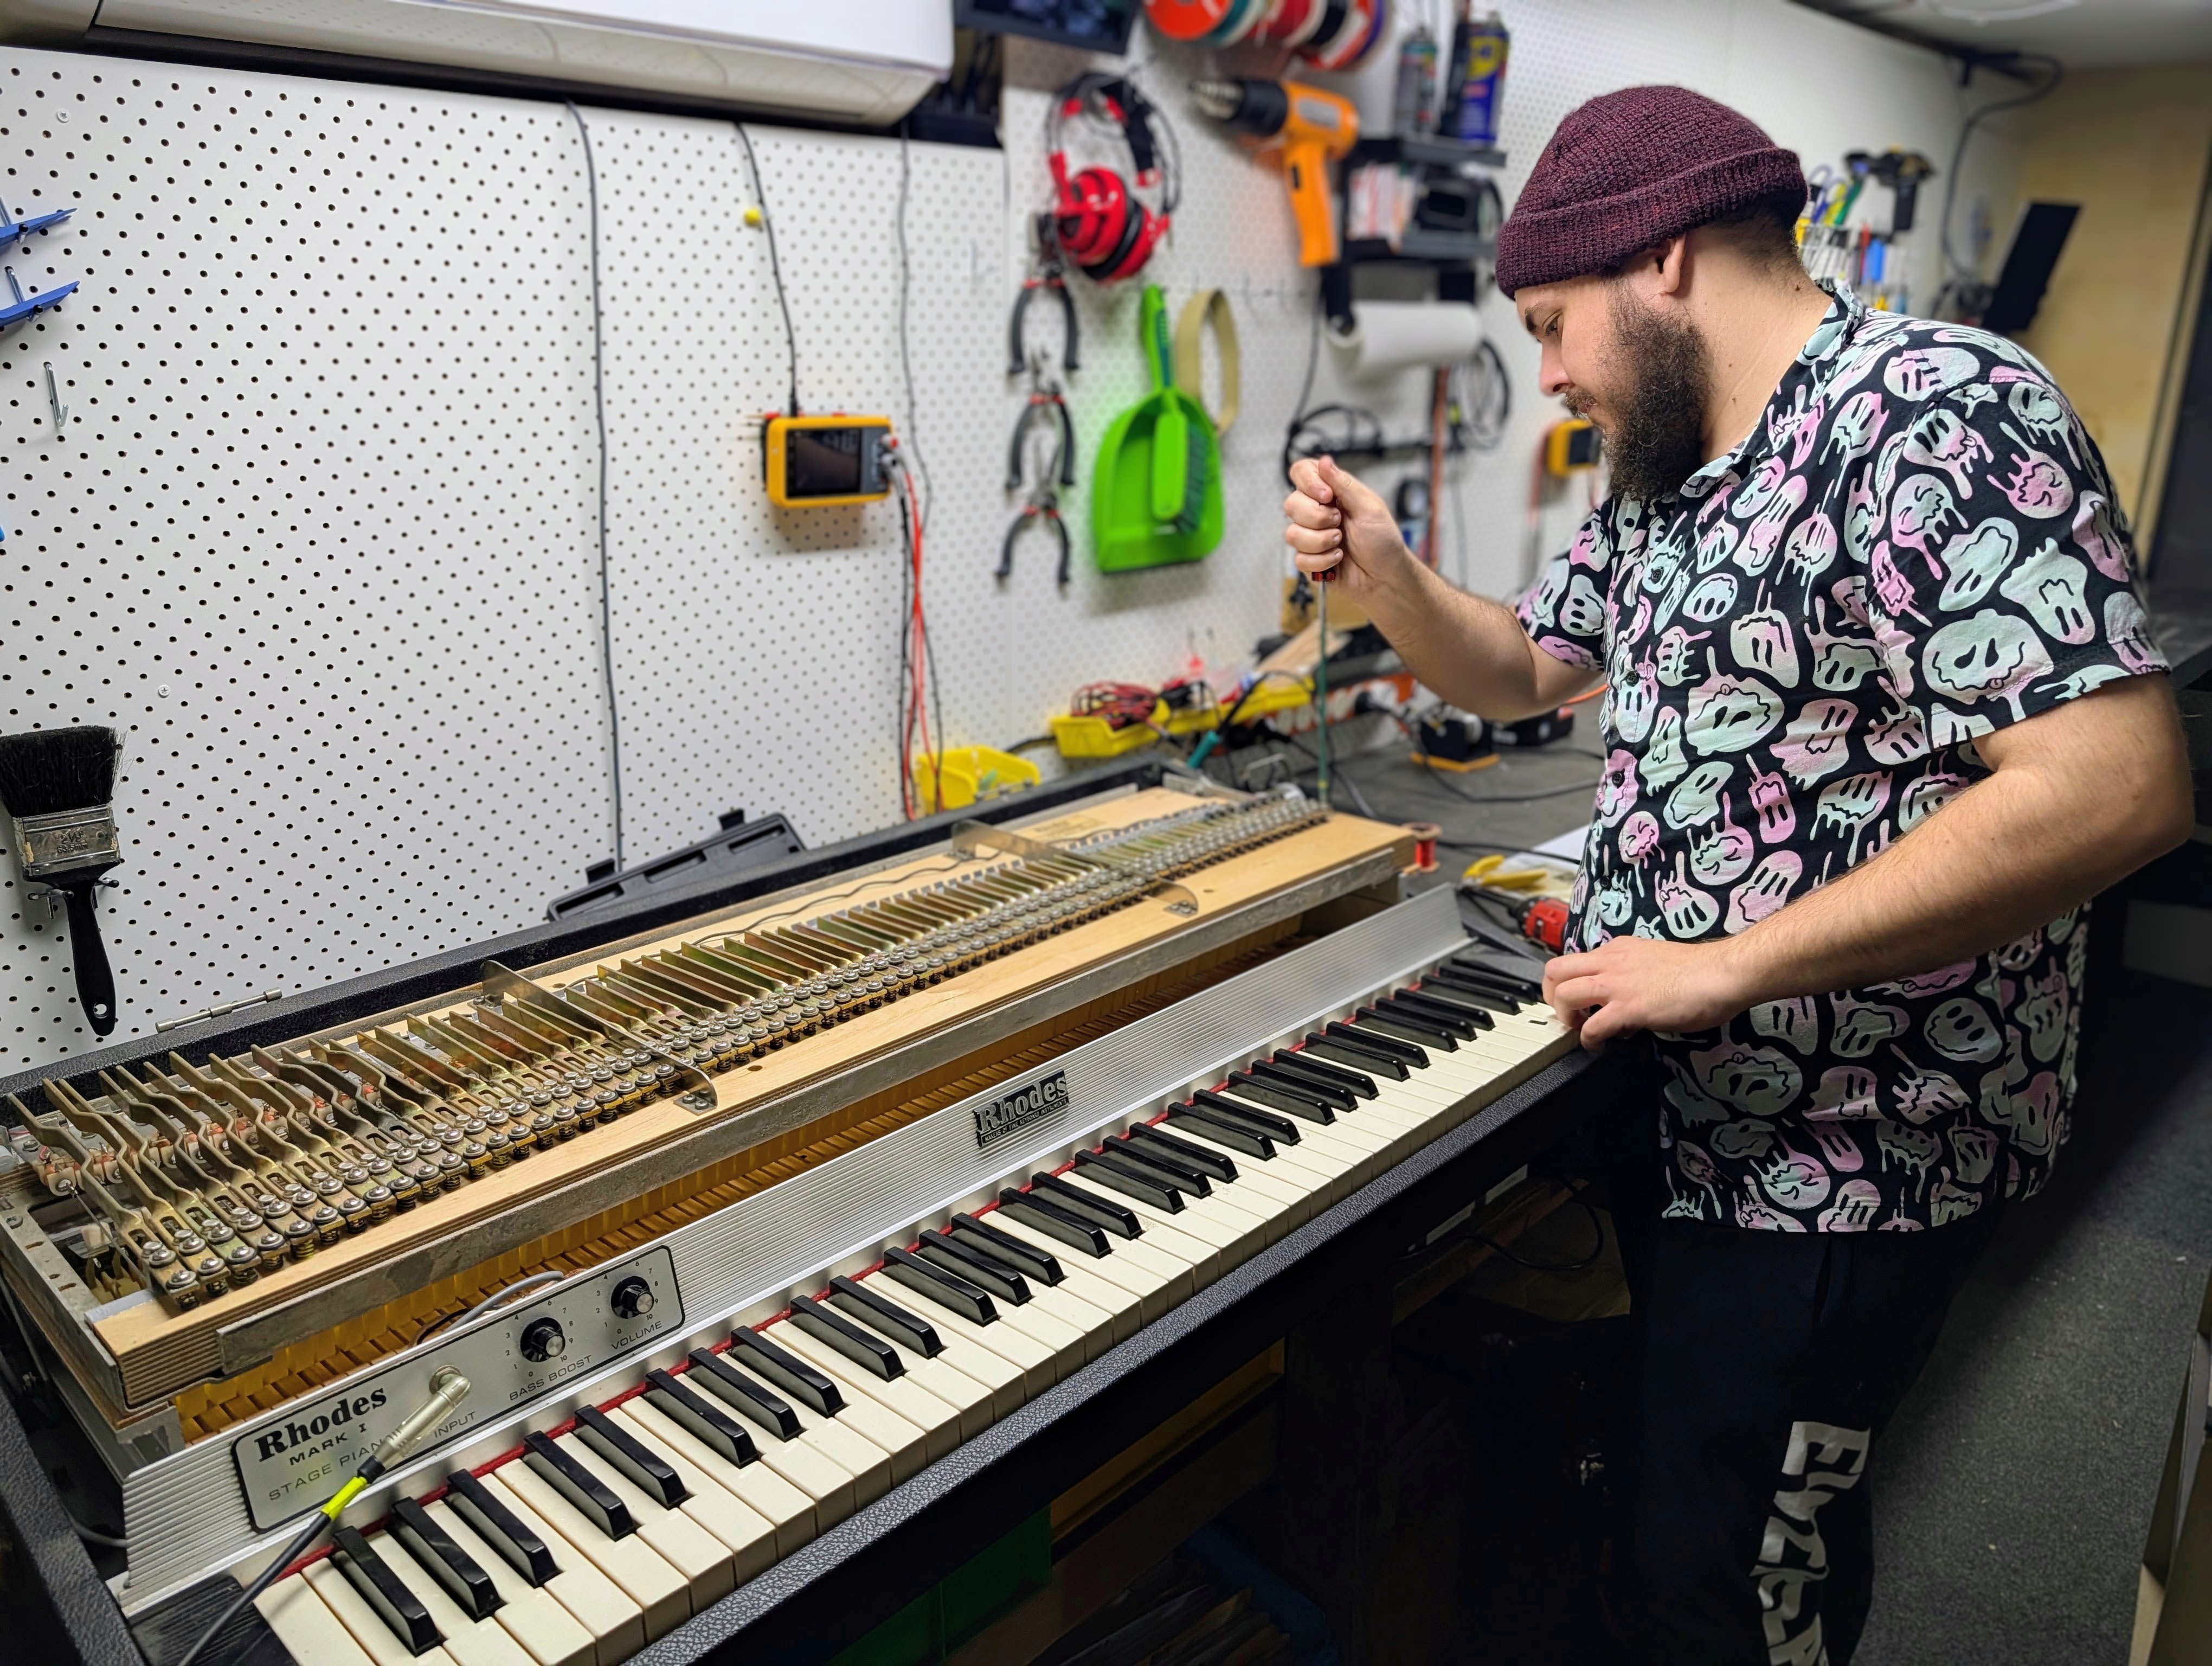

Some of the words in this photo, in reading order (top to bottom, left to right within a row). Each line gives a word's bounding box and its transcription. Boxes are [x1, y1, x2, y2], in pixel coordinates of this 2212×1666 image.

[976, 1077, 1068, 1135] Rhodes
[985, 1130, 1001, 1142] MAKERS
[1009, 1122, 1019, 1131] FINE
[1020, 1112, 1040, 1125] KEYBOARD
[1041, 1099, 1067, 1116] INSTRUMENTS
[611, 1321, 662, 1349] VOLUME
[509, 1379, 544, 1401] BASS
[548, 1355, 591, 1381] BOOST
[254, 1388, 387, 1462] Rhodes
[289, 1432, 348, 1465] MARK
[359, 1423, 366, 1433] I
[434, 1411, 475, 1438] INPUT
[269, 1464, 332, 1501] STAGE
[339, 1438, 383, 1466] PIAN
